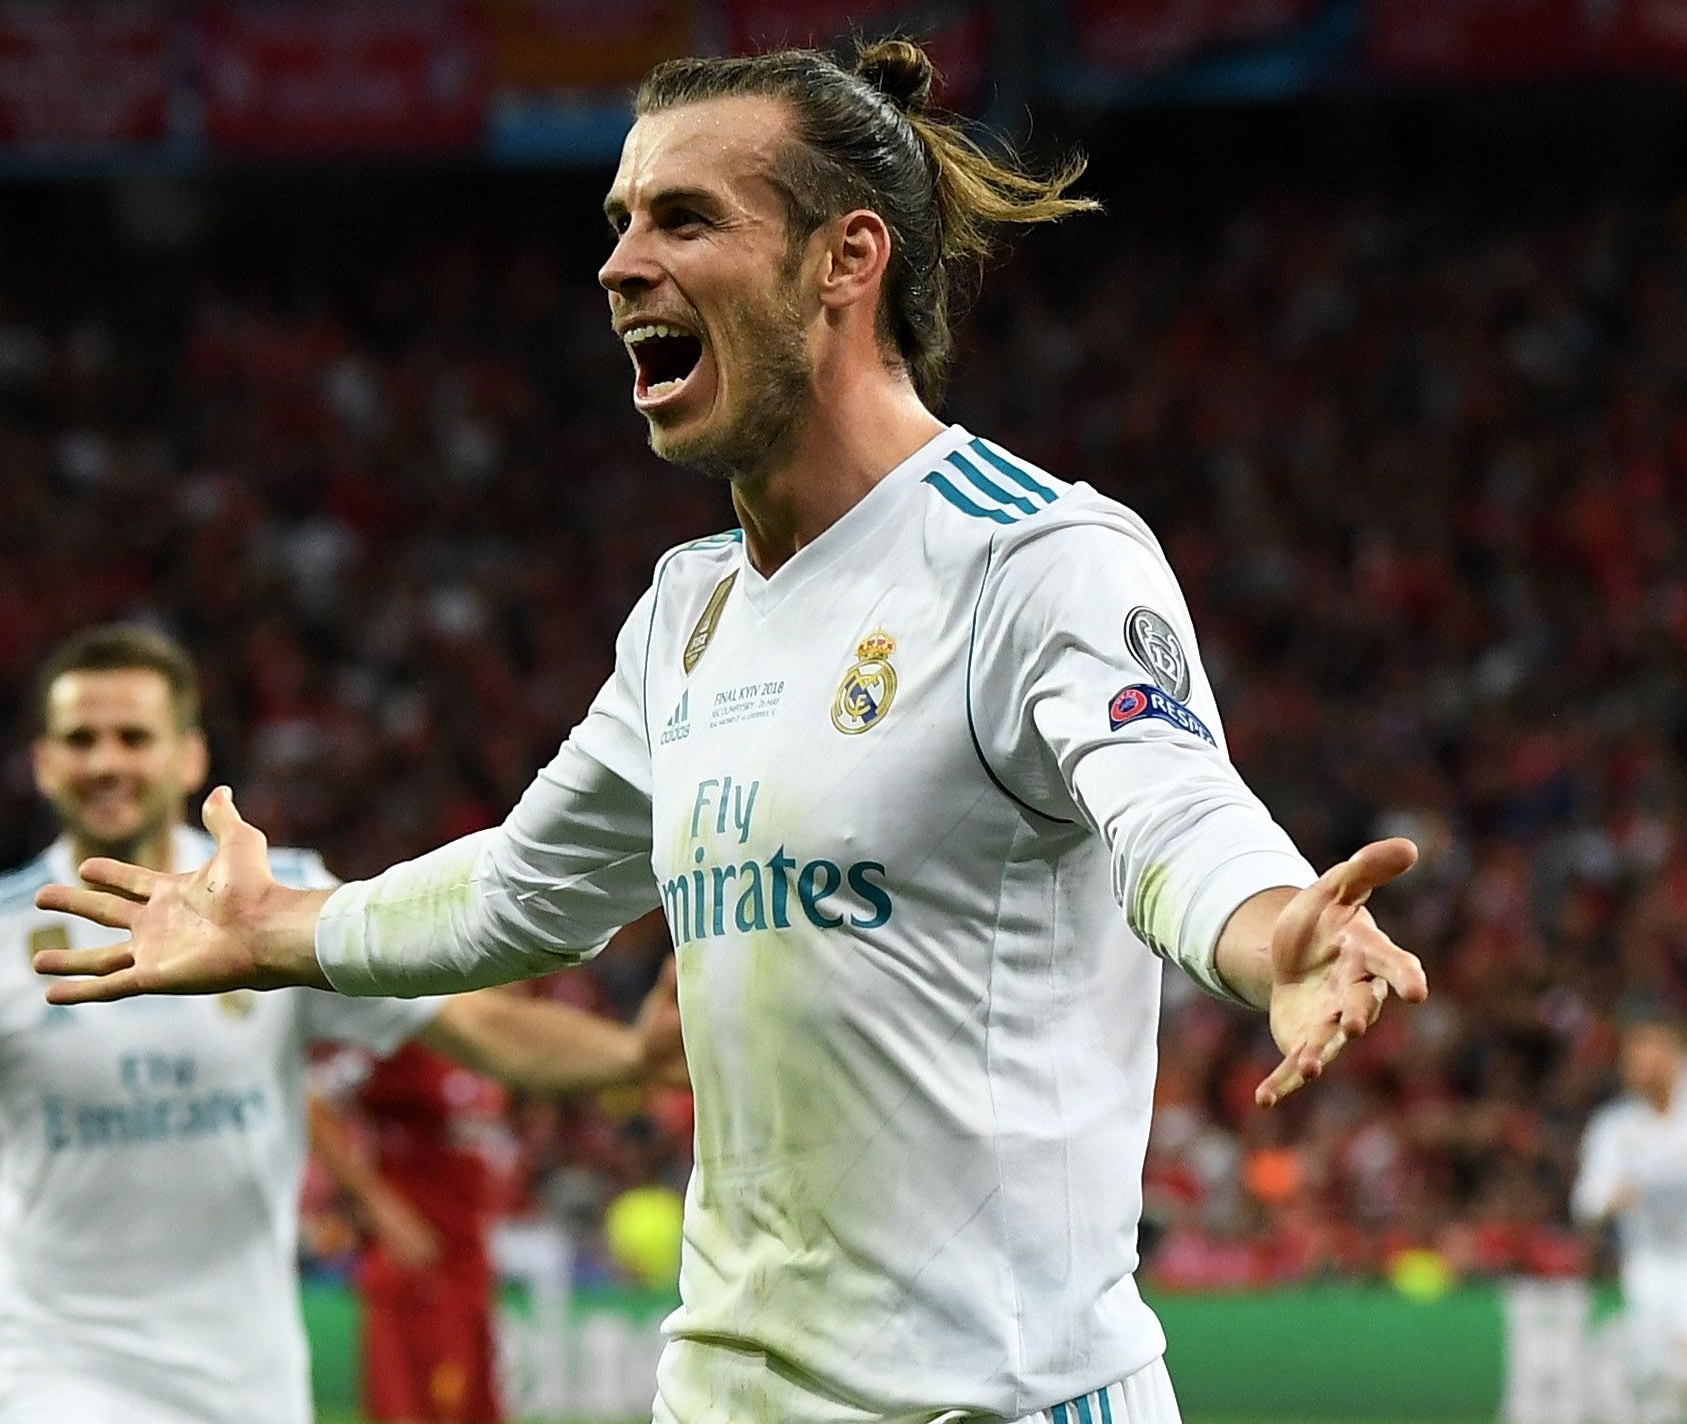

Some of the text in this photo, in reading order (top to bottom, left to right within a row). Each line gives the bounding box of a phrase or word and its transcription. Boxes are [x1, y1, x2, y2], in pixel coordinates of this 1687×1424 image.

[762, 681, 784, 696] 2018
[691, 776, 759, 844] Fly
[662, 844, 893, 948] mirates
